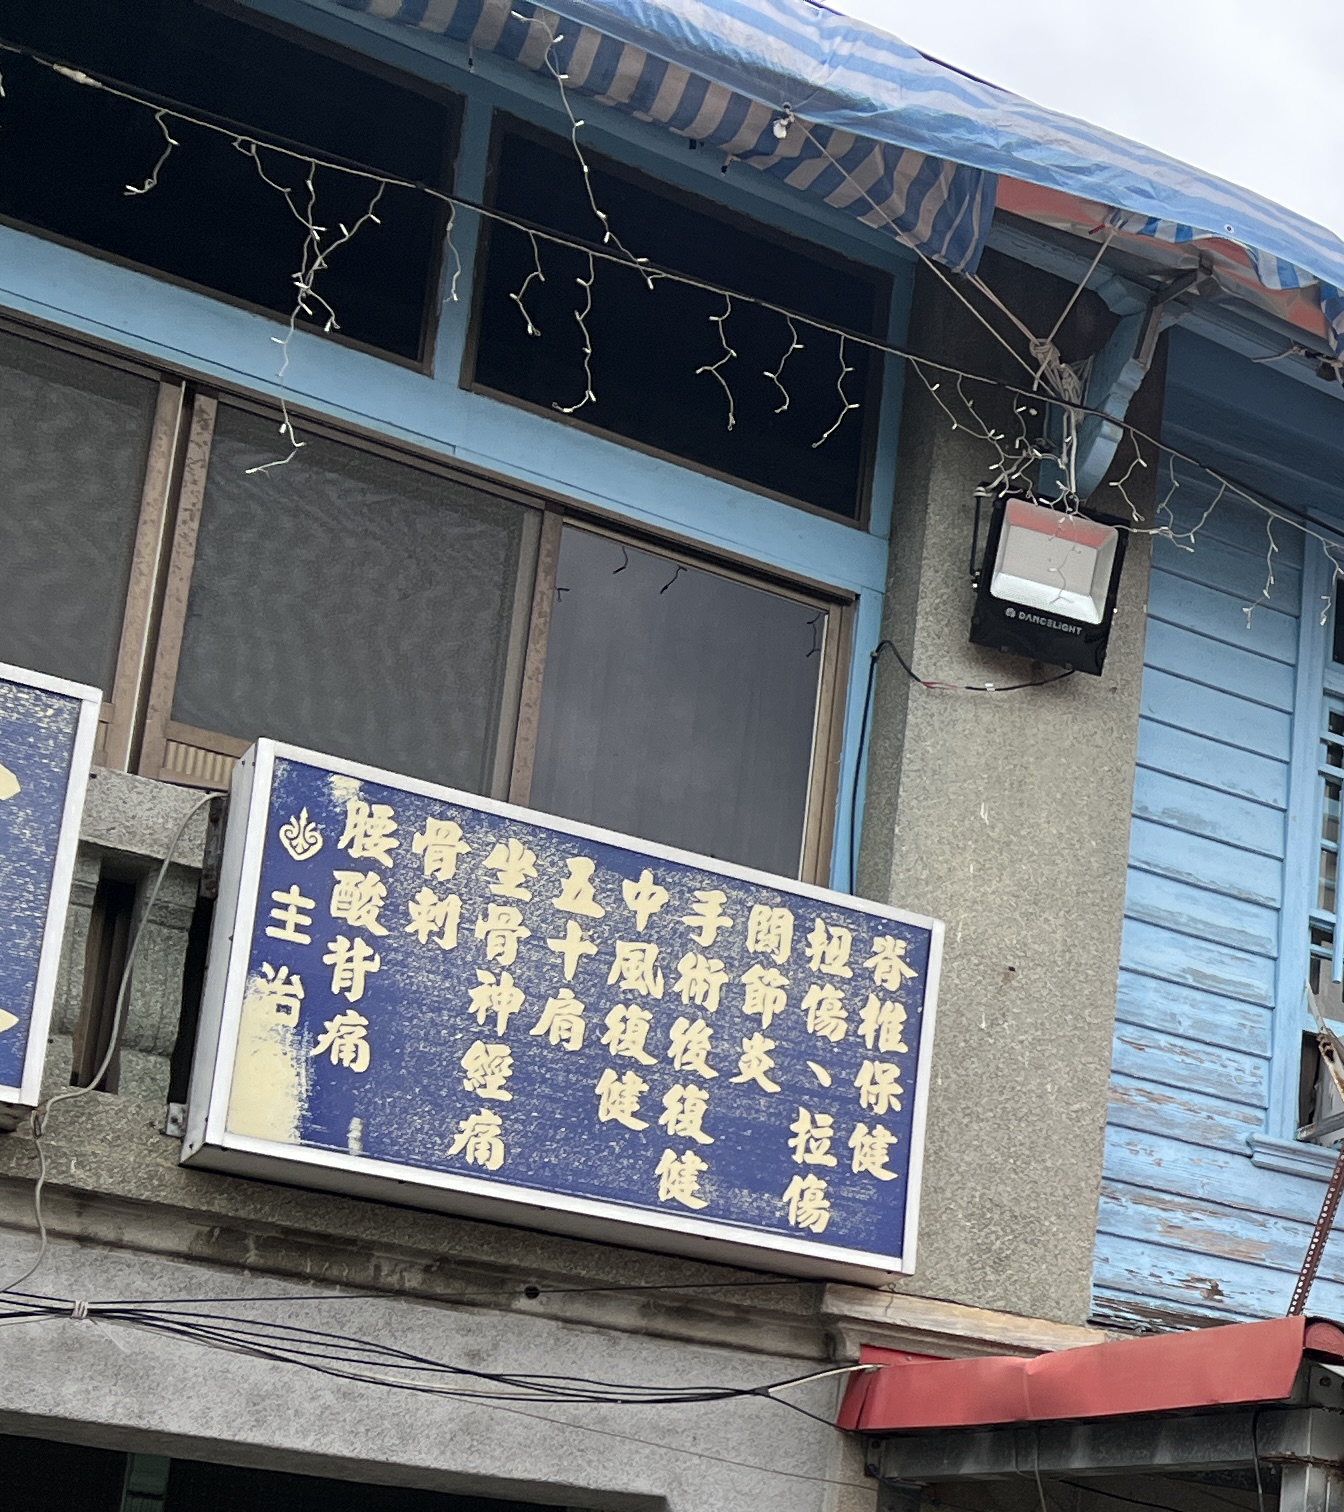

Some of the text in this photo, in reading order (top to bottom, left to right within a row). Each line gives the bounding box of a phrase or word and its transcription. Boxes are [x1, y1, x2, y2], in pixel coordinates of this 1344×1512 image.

[255, 884, 317, 1031] 主治
[314, 798, 399, 1074] 腰酸背痛
[406, 816, 472, 952] 骨刺
[448, 836, 539, 1172] 坐骨神經痛
[531, 856, 606, 1053] 五十肩
[595, 868, 670, 1133] 中風復健
[729, 902, 796, 1095] 關節炎
[654, 888, 734, 1212] 手術後復健
[782, 918, 855, 1235] 扭傷、拉傷
[848, 933, 920, 1184] 脊椎保健
